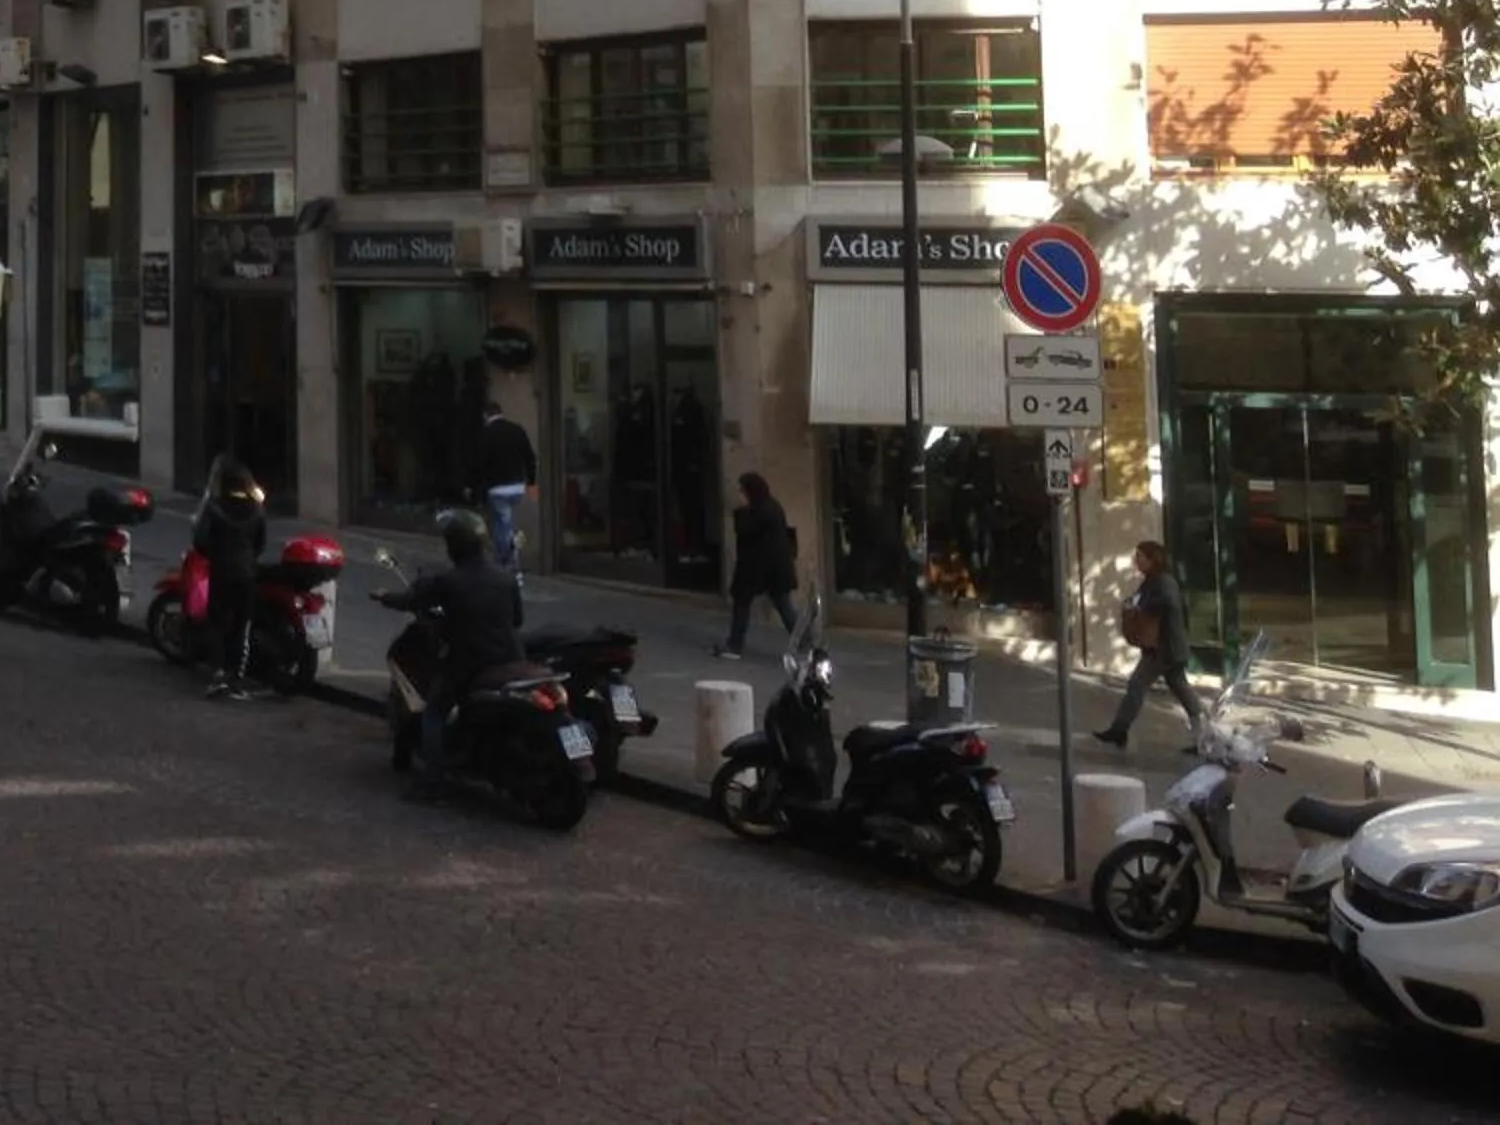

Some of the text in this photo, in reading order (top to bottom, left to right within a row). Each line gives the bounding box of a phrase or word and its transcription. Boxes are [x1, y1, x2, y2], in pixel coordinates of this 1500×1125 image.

[348, 234, 456, 265] Adam's Shop
[549, 233, 681, 264] Adam's Shop
[950, 233, 1010, 260] Sho
[1057, 395, 1090, 415] 24
